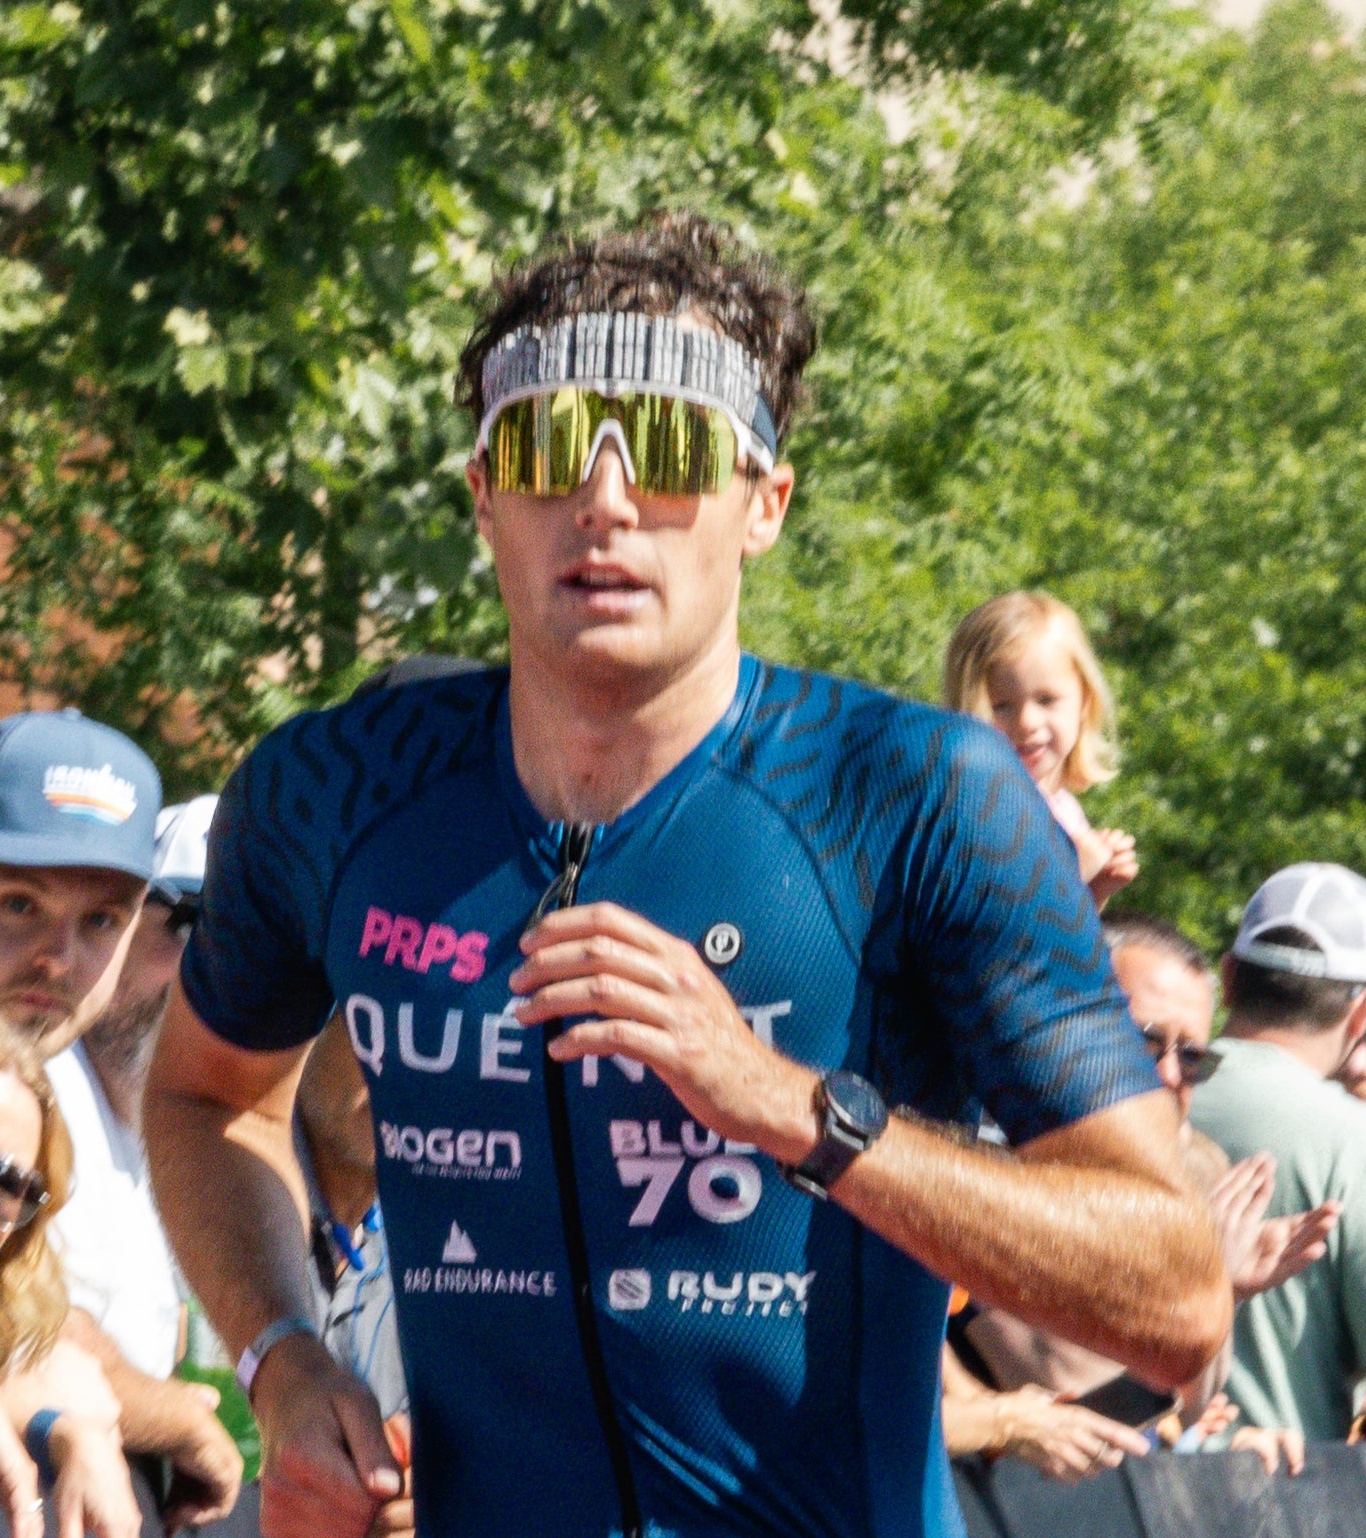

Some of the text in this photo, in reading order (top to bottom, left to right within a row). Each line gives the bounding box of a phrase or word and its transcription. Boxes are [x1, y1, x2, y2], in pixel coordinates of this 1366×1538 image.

[358, 904, 490, 984] PRPS
[616, 1154, 762, 1226] 70
[434, 1266, 557, 1297] ENDURANCE
[668, 1270, 816, 1301] RUDY
